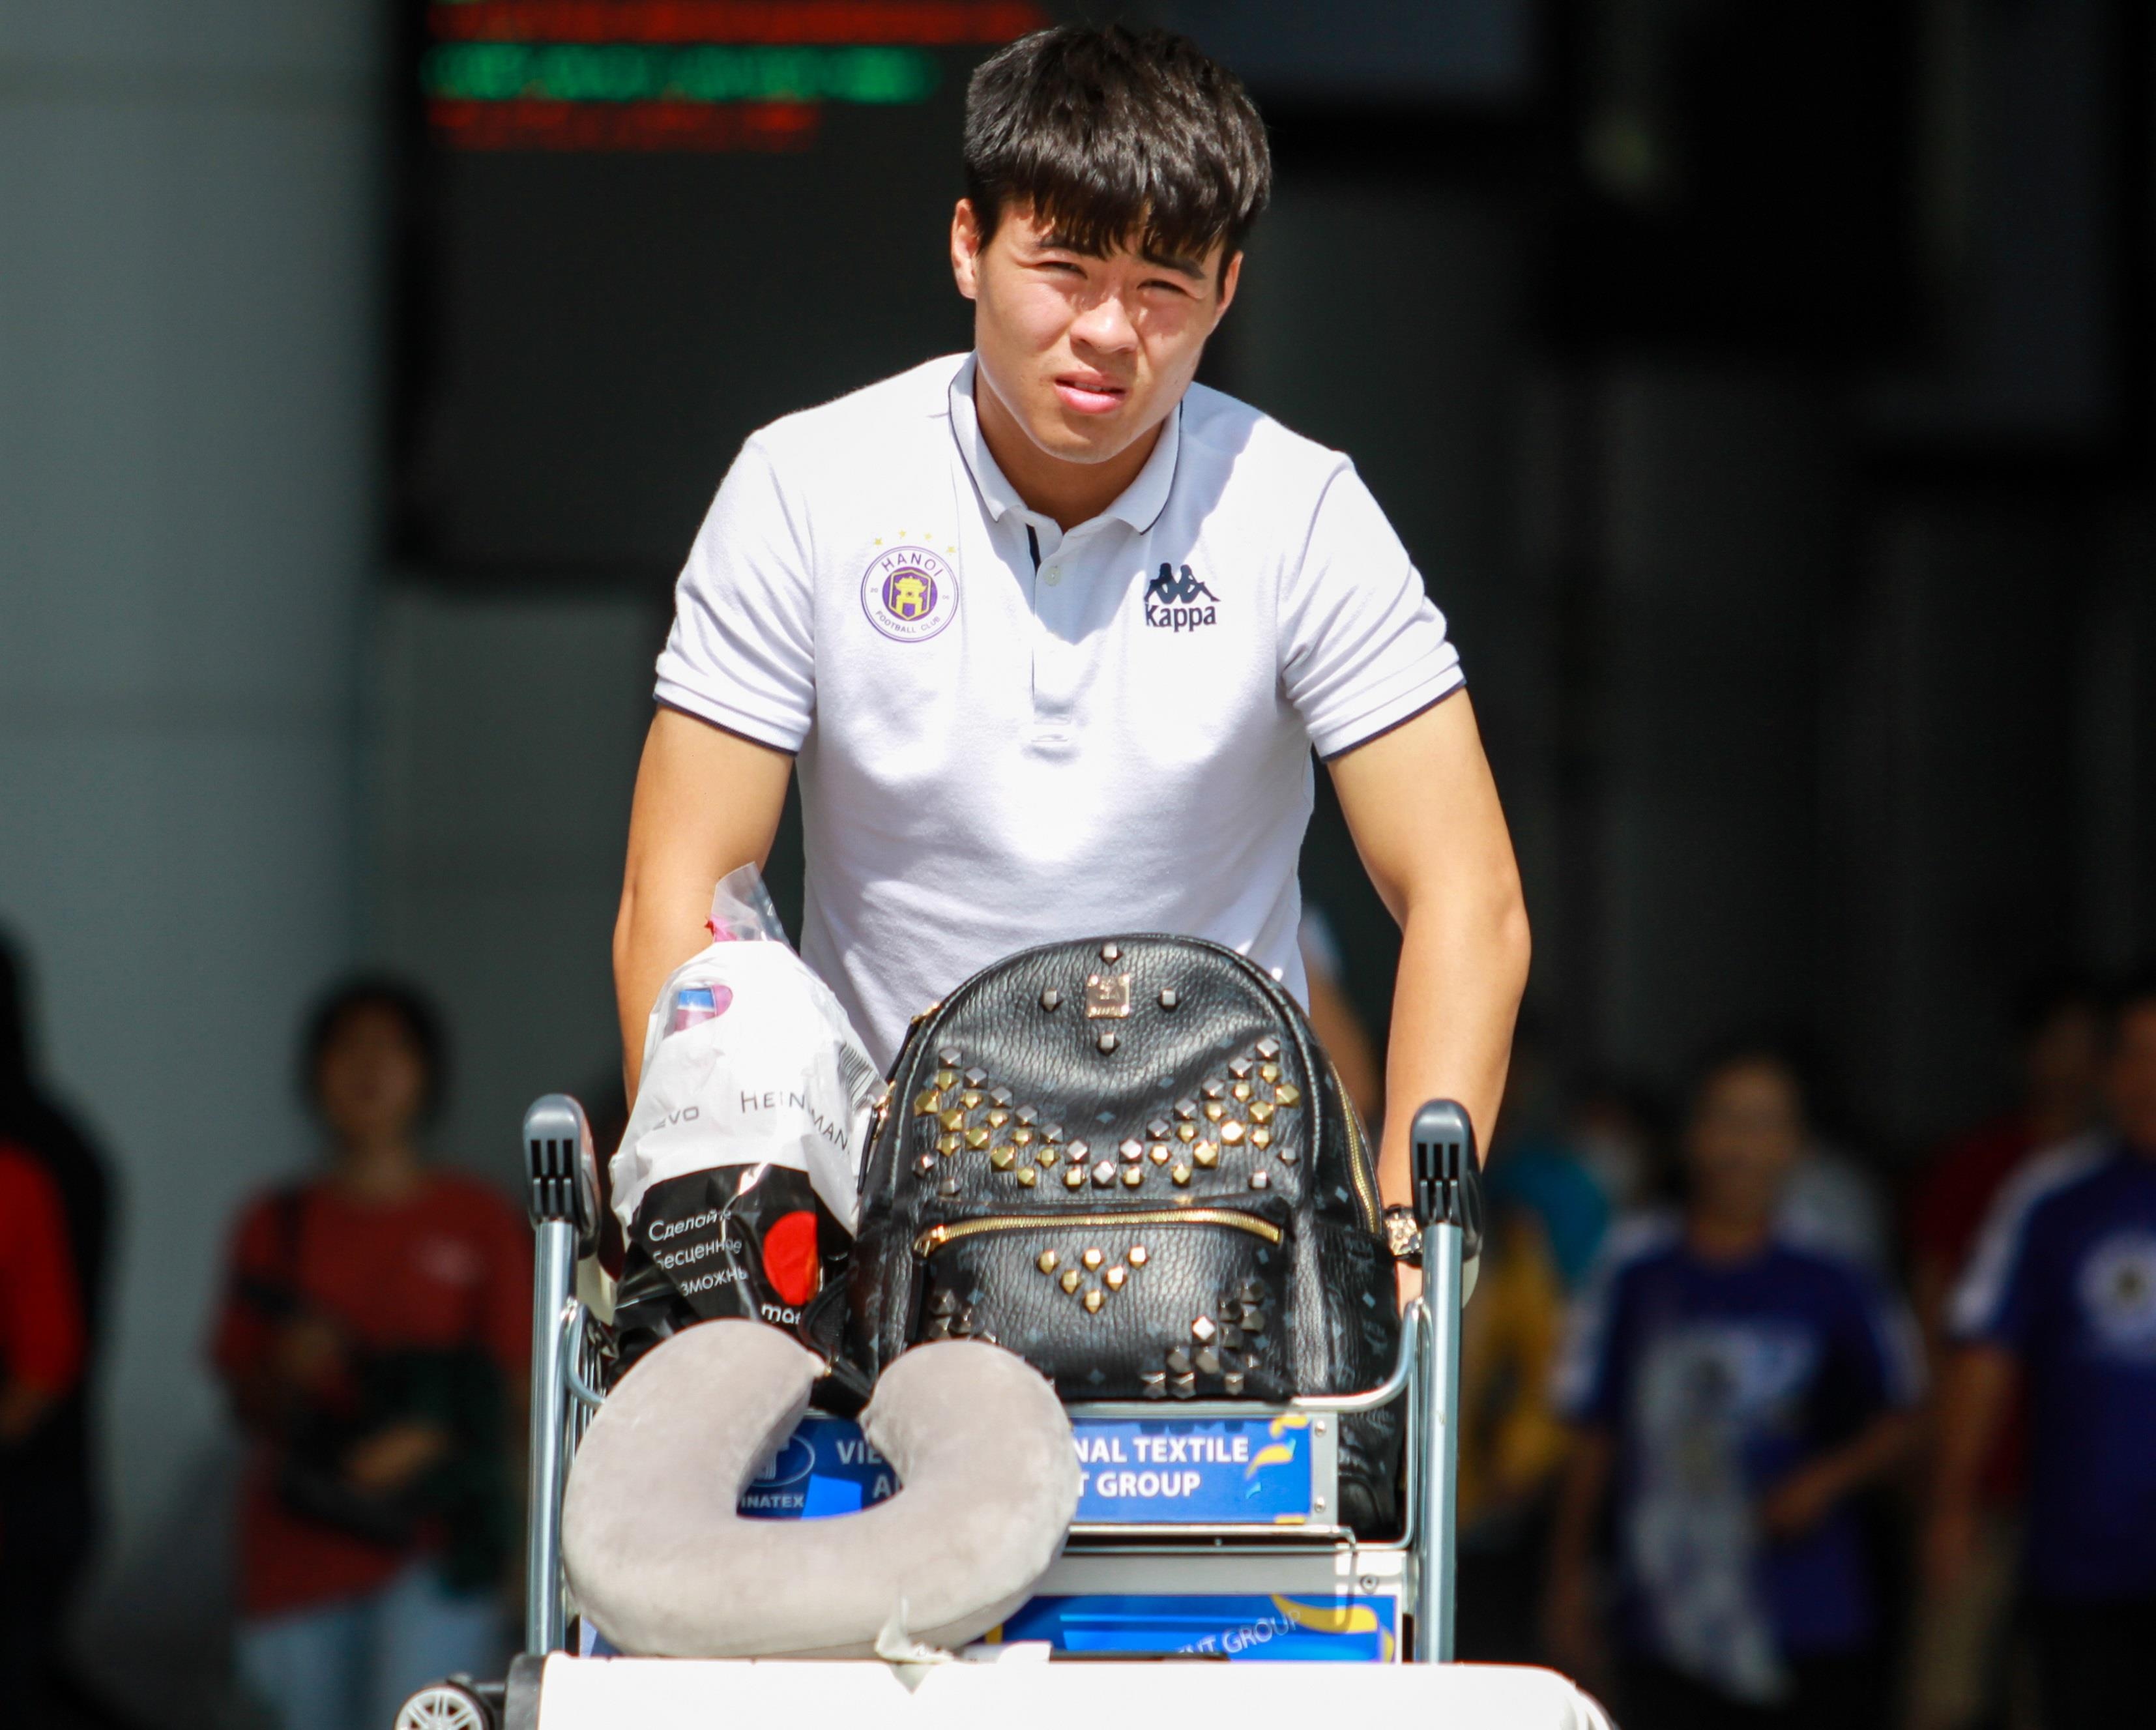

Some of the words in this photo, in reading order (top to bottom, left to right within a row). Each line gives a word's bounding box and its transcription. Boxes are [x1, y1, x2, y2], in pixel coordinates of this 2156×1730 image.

[881, 552, 944, 577] HANOI
[875, 610, 916, 634] FOOTBALL
[920, 616, 941, 632] CLUB
[1145, 603, 1217, 632] Kappa
[1133, 1437, 1249, 1463] TEXTILE
[1096, 1471, 1201, 1497] GROUP
[741, 1493, 804, 1508] INATEX
[1221, 1608, 1302, 1654] GROUP
